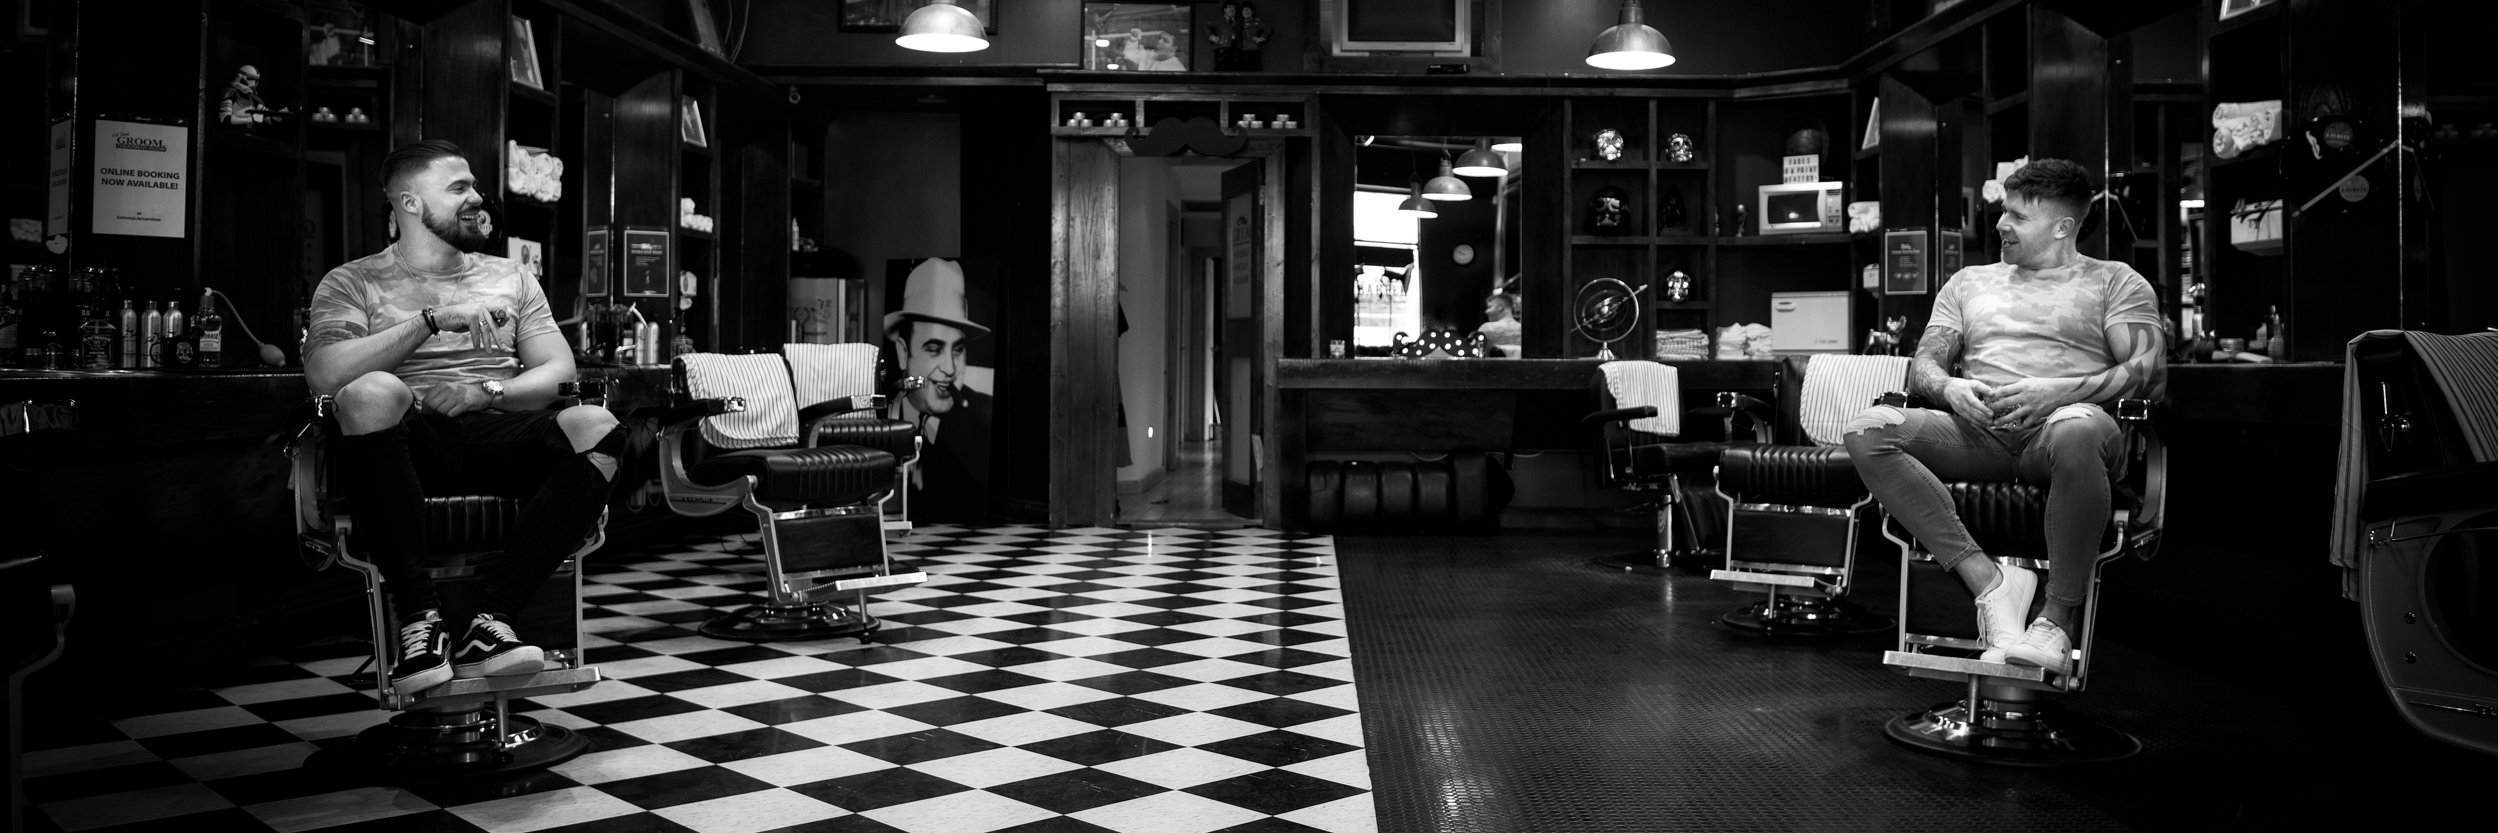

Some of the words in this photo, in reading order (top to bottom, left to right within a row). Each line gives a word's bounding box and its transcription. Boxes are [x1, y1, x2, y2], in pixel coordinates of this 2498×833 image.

[117, 136, 163, 146] GROOM
[101, 167, 135, 177] ONLINE
[137, 170, 180, 180] BOOKING
[101, 178, 124, 186] NOW
[126, 180, 179, 190] AVAILABLE!
